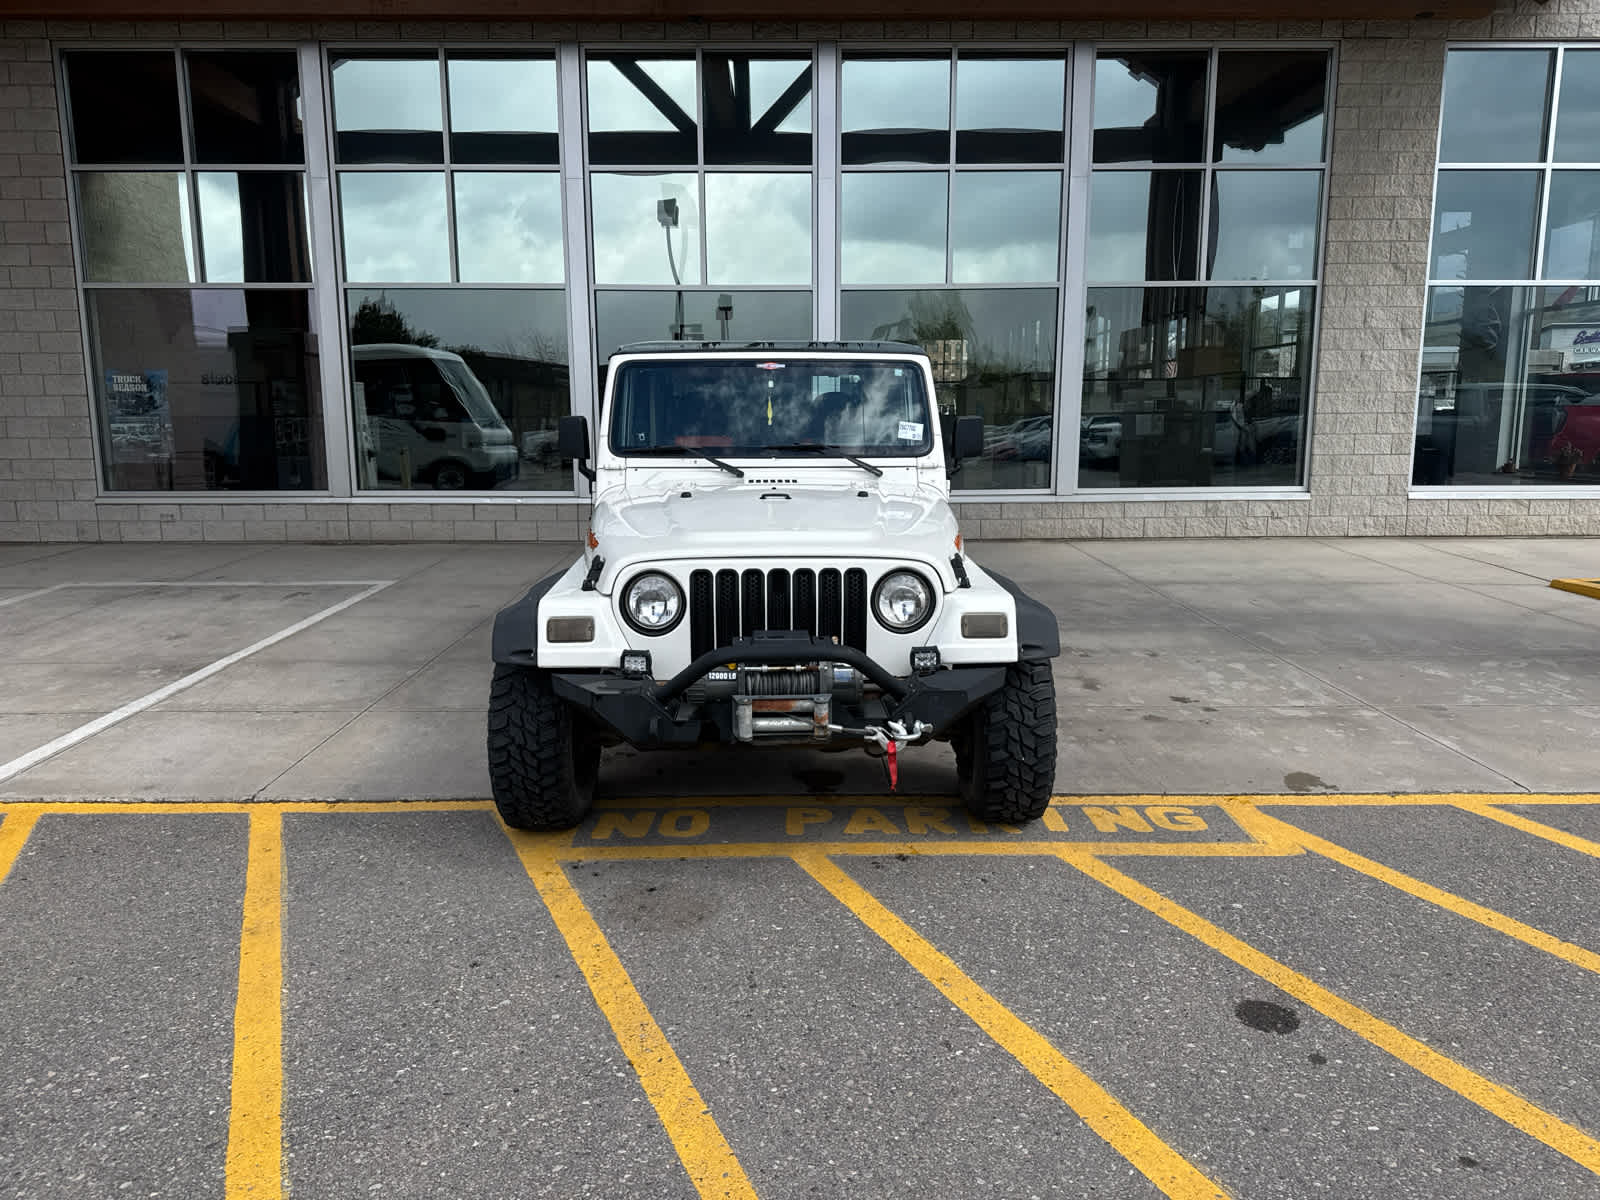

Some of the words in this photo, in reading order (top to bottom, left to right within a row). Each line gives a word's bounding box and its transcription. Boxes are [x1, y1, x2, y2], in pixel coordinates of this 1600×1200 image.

[111, 375, 142, 384] TRUCK
[112, 384, 148, 393] SEASON
[591, 809, 711, 840] NO
